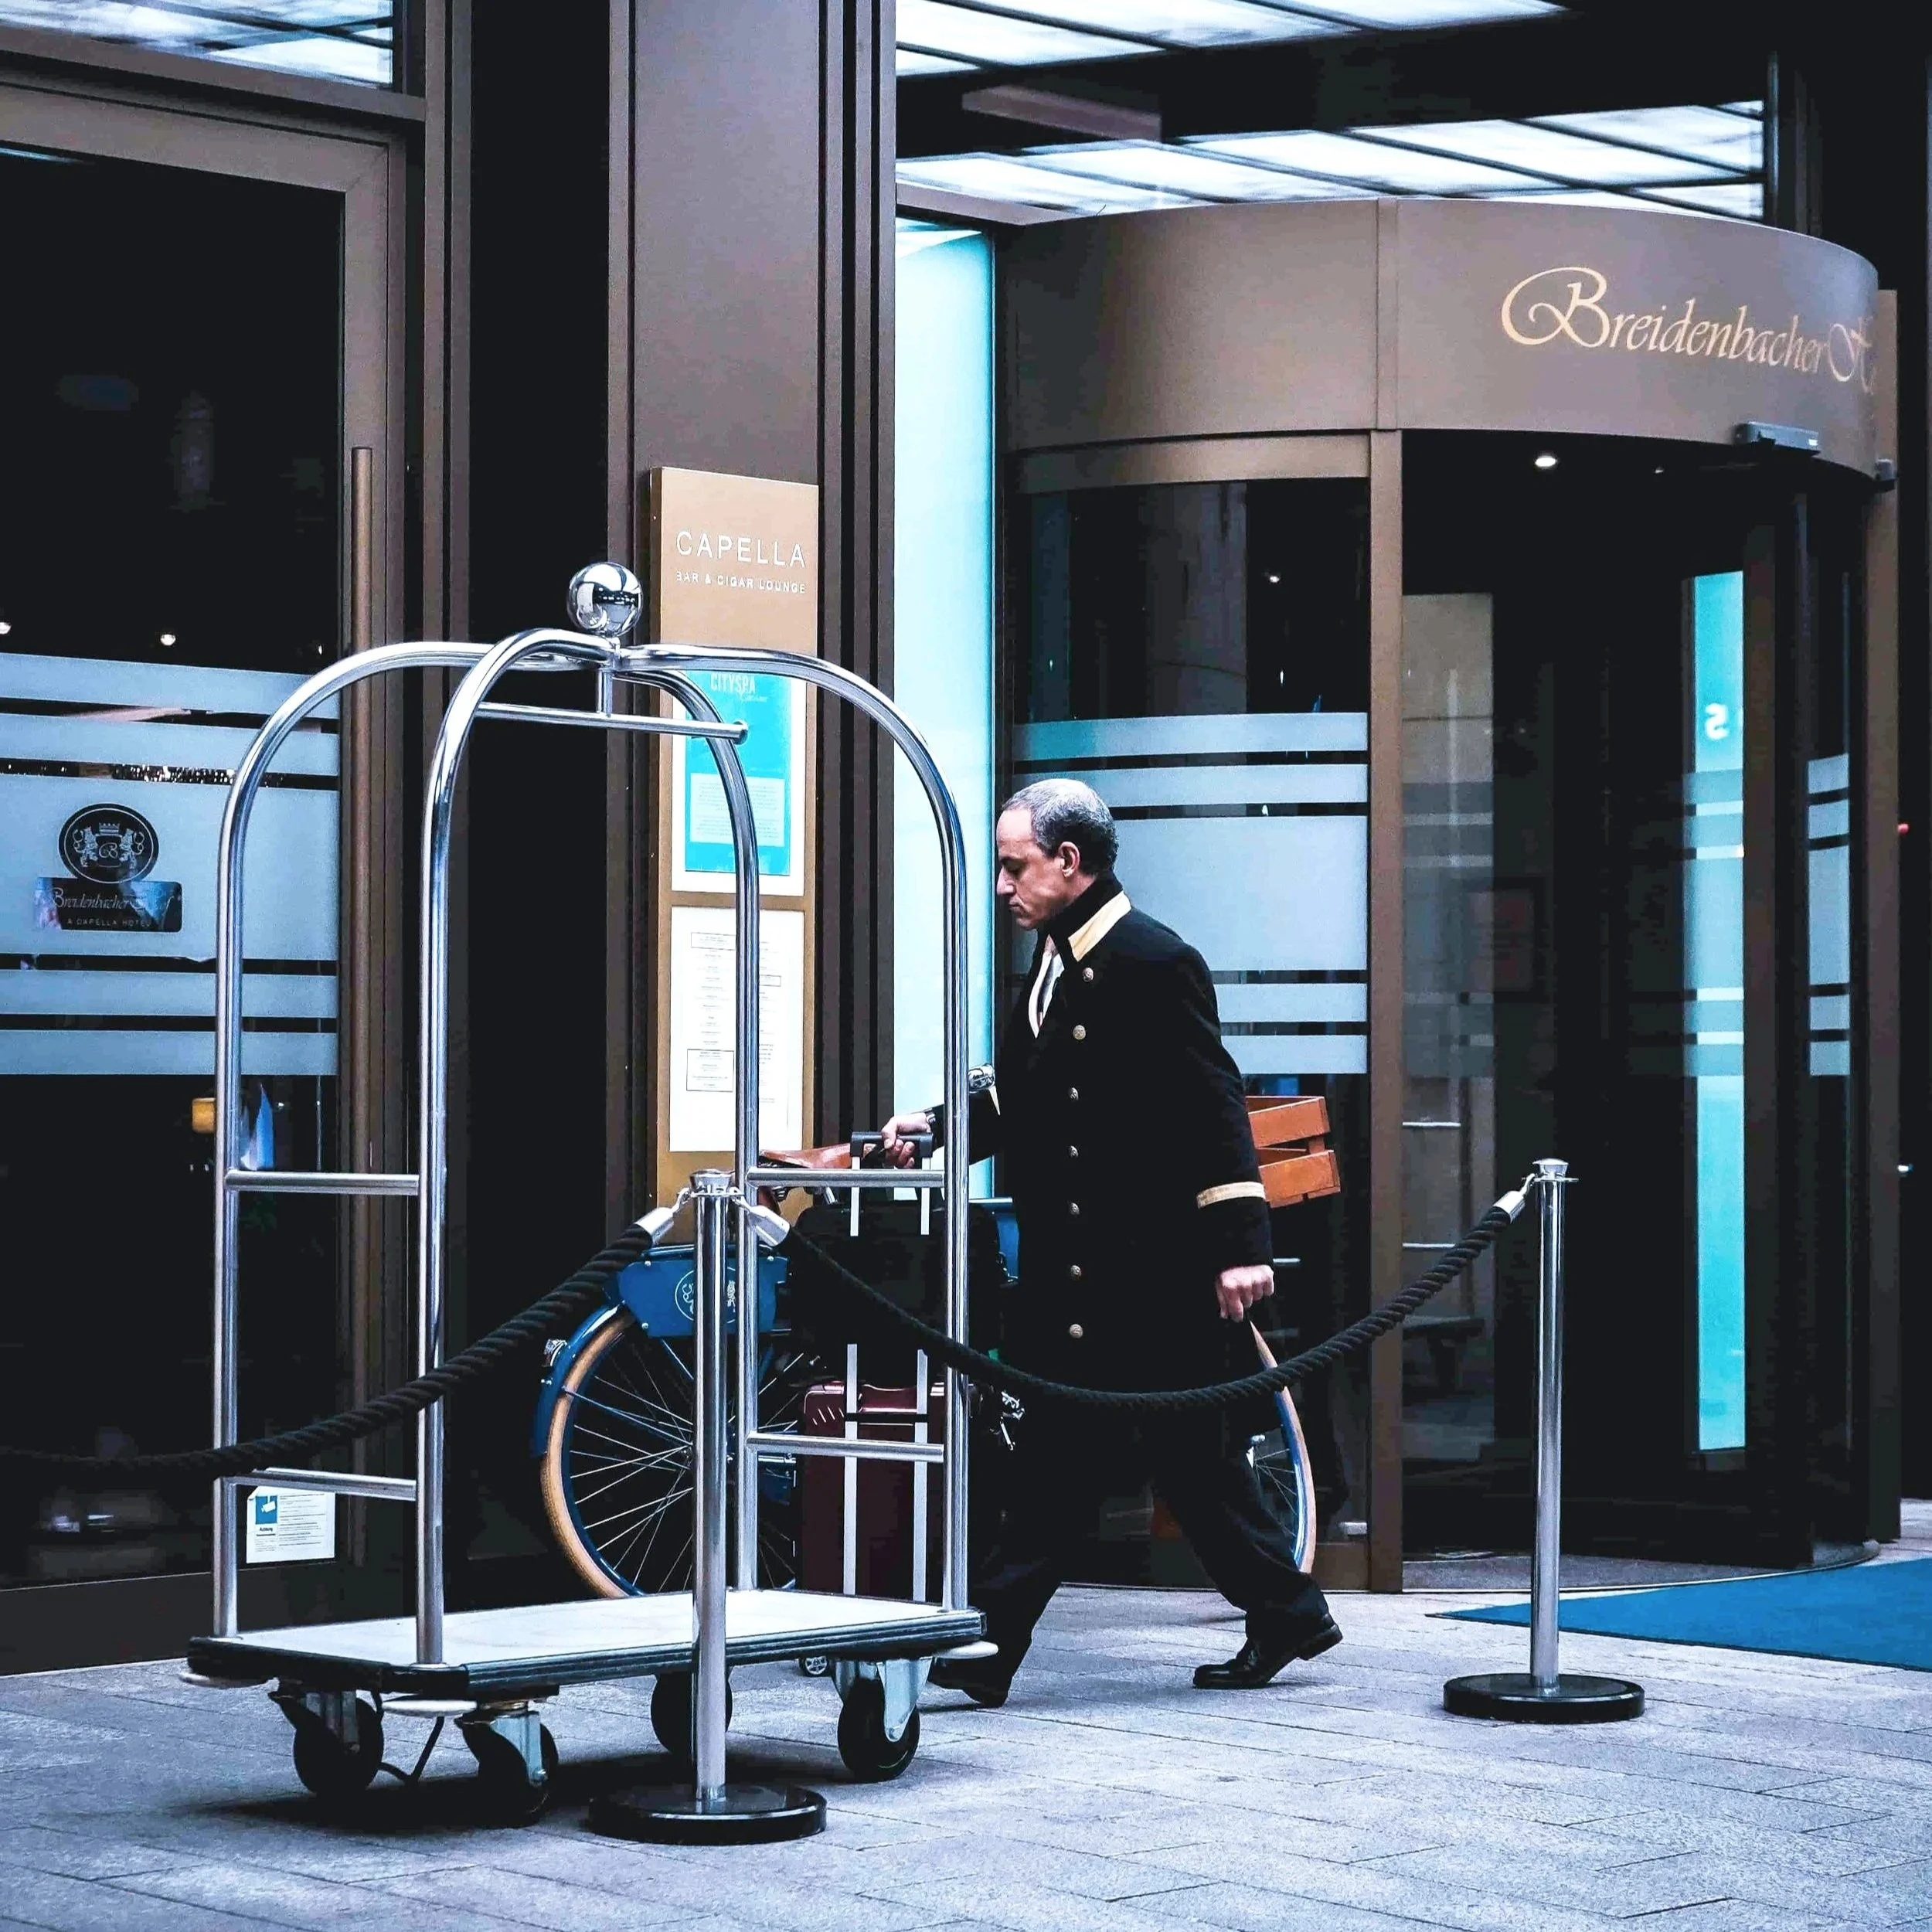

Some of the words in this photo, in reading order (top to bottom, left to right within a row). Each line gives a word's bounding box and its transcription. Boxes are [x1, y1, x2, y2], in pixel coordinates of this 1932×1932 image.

[1501, 266, 1827, 375] Breidenbacher
[675, 530, 805, 569] CAPELLA
[676, 570, 699, 583] BAR
[705, 573, 712, 585] &
[717, 575, 754, 589] CIGAR
[759, 577, 806, 594] LOUNGE
[710, 672, 756, 694] CITYSPA
[76, 918, 118, 927] CAPELLA
